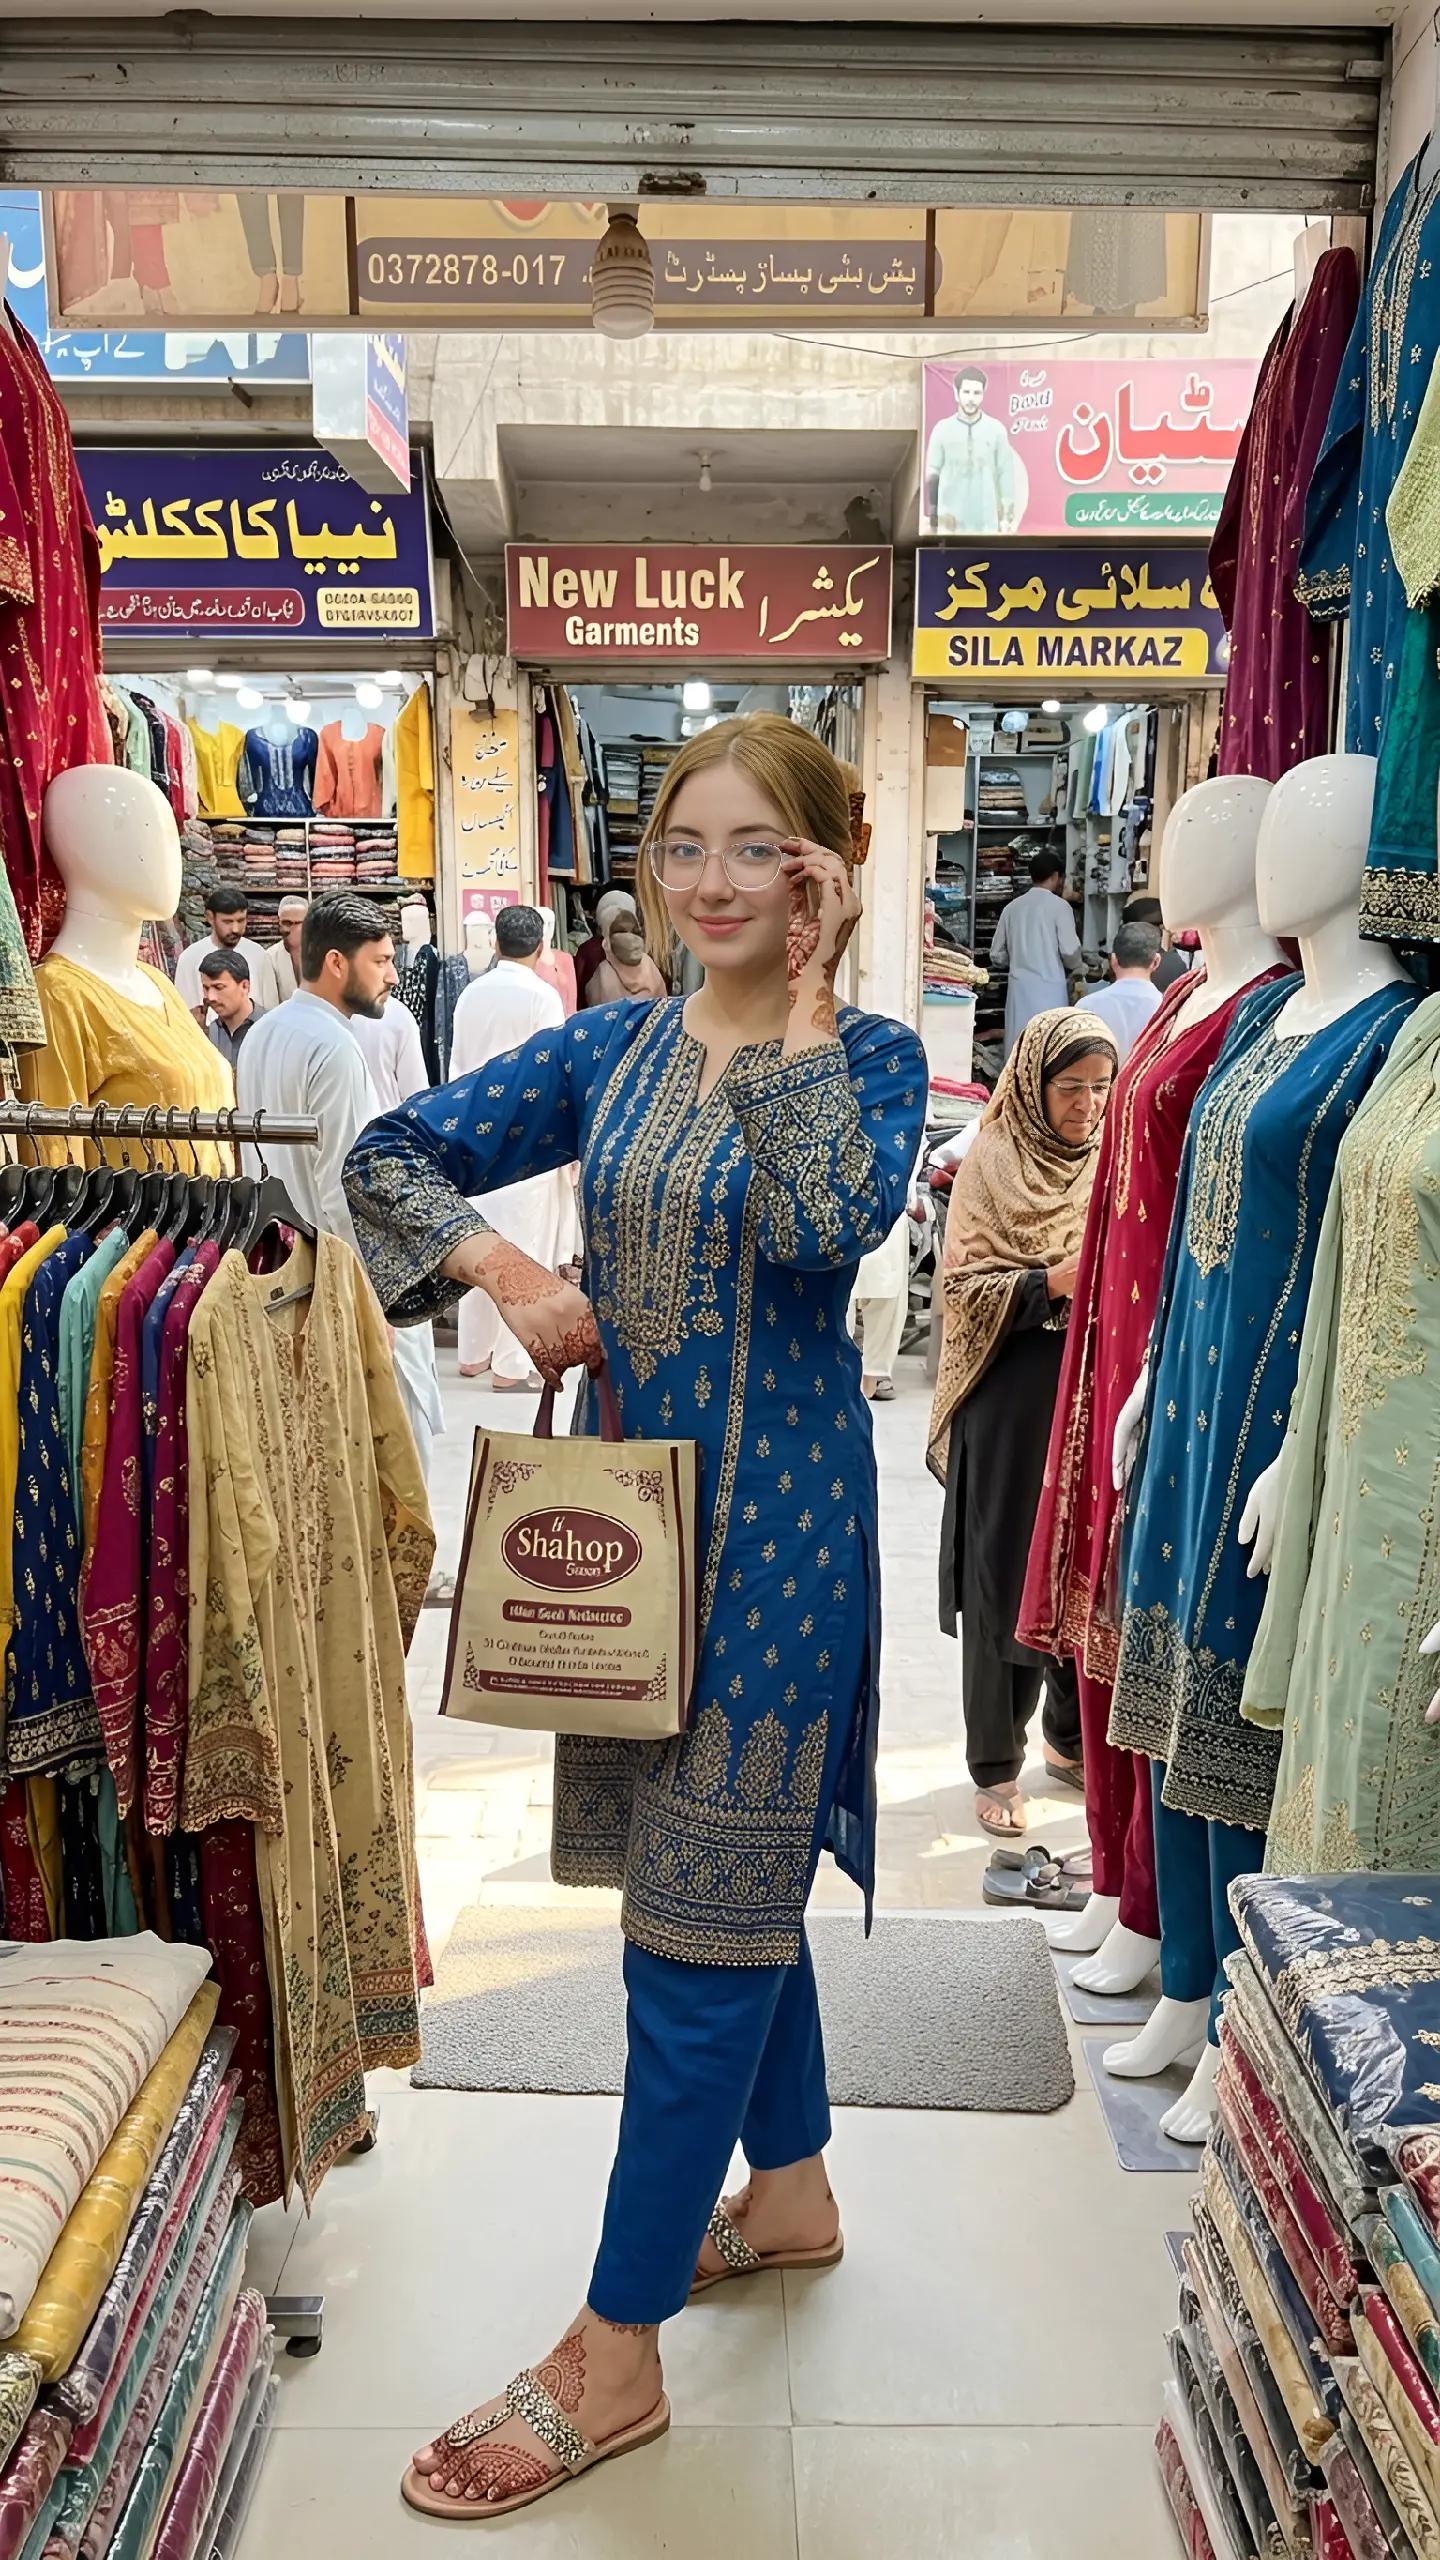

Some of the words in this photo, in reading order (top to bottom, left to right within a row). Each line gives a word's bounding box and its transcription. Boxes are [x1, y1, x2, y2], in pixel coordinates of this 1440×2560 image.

[368, 253, 566, 286] 0372878-017
[518, 556, 618, 609] New
[635, 557, 745, 609] Luck
[934, 562, 1047, 622] مرکز
[565, 615, 700, 646] Garments
[948, 635, 1024, 667] SILA
[1037, 636, 1183, 667] MARKAZ
[517, 1526, 624, 1574] Shahop
